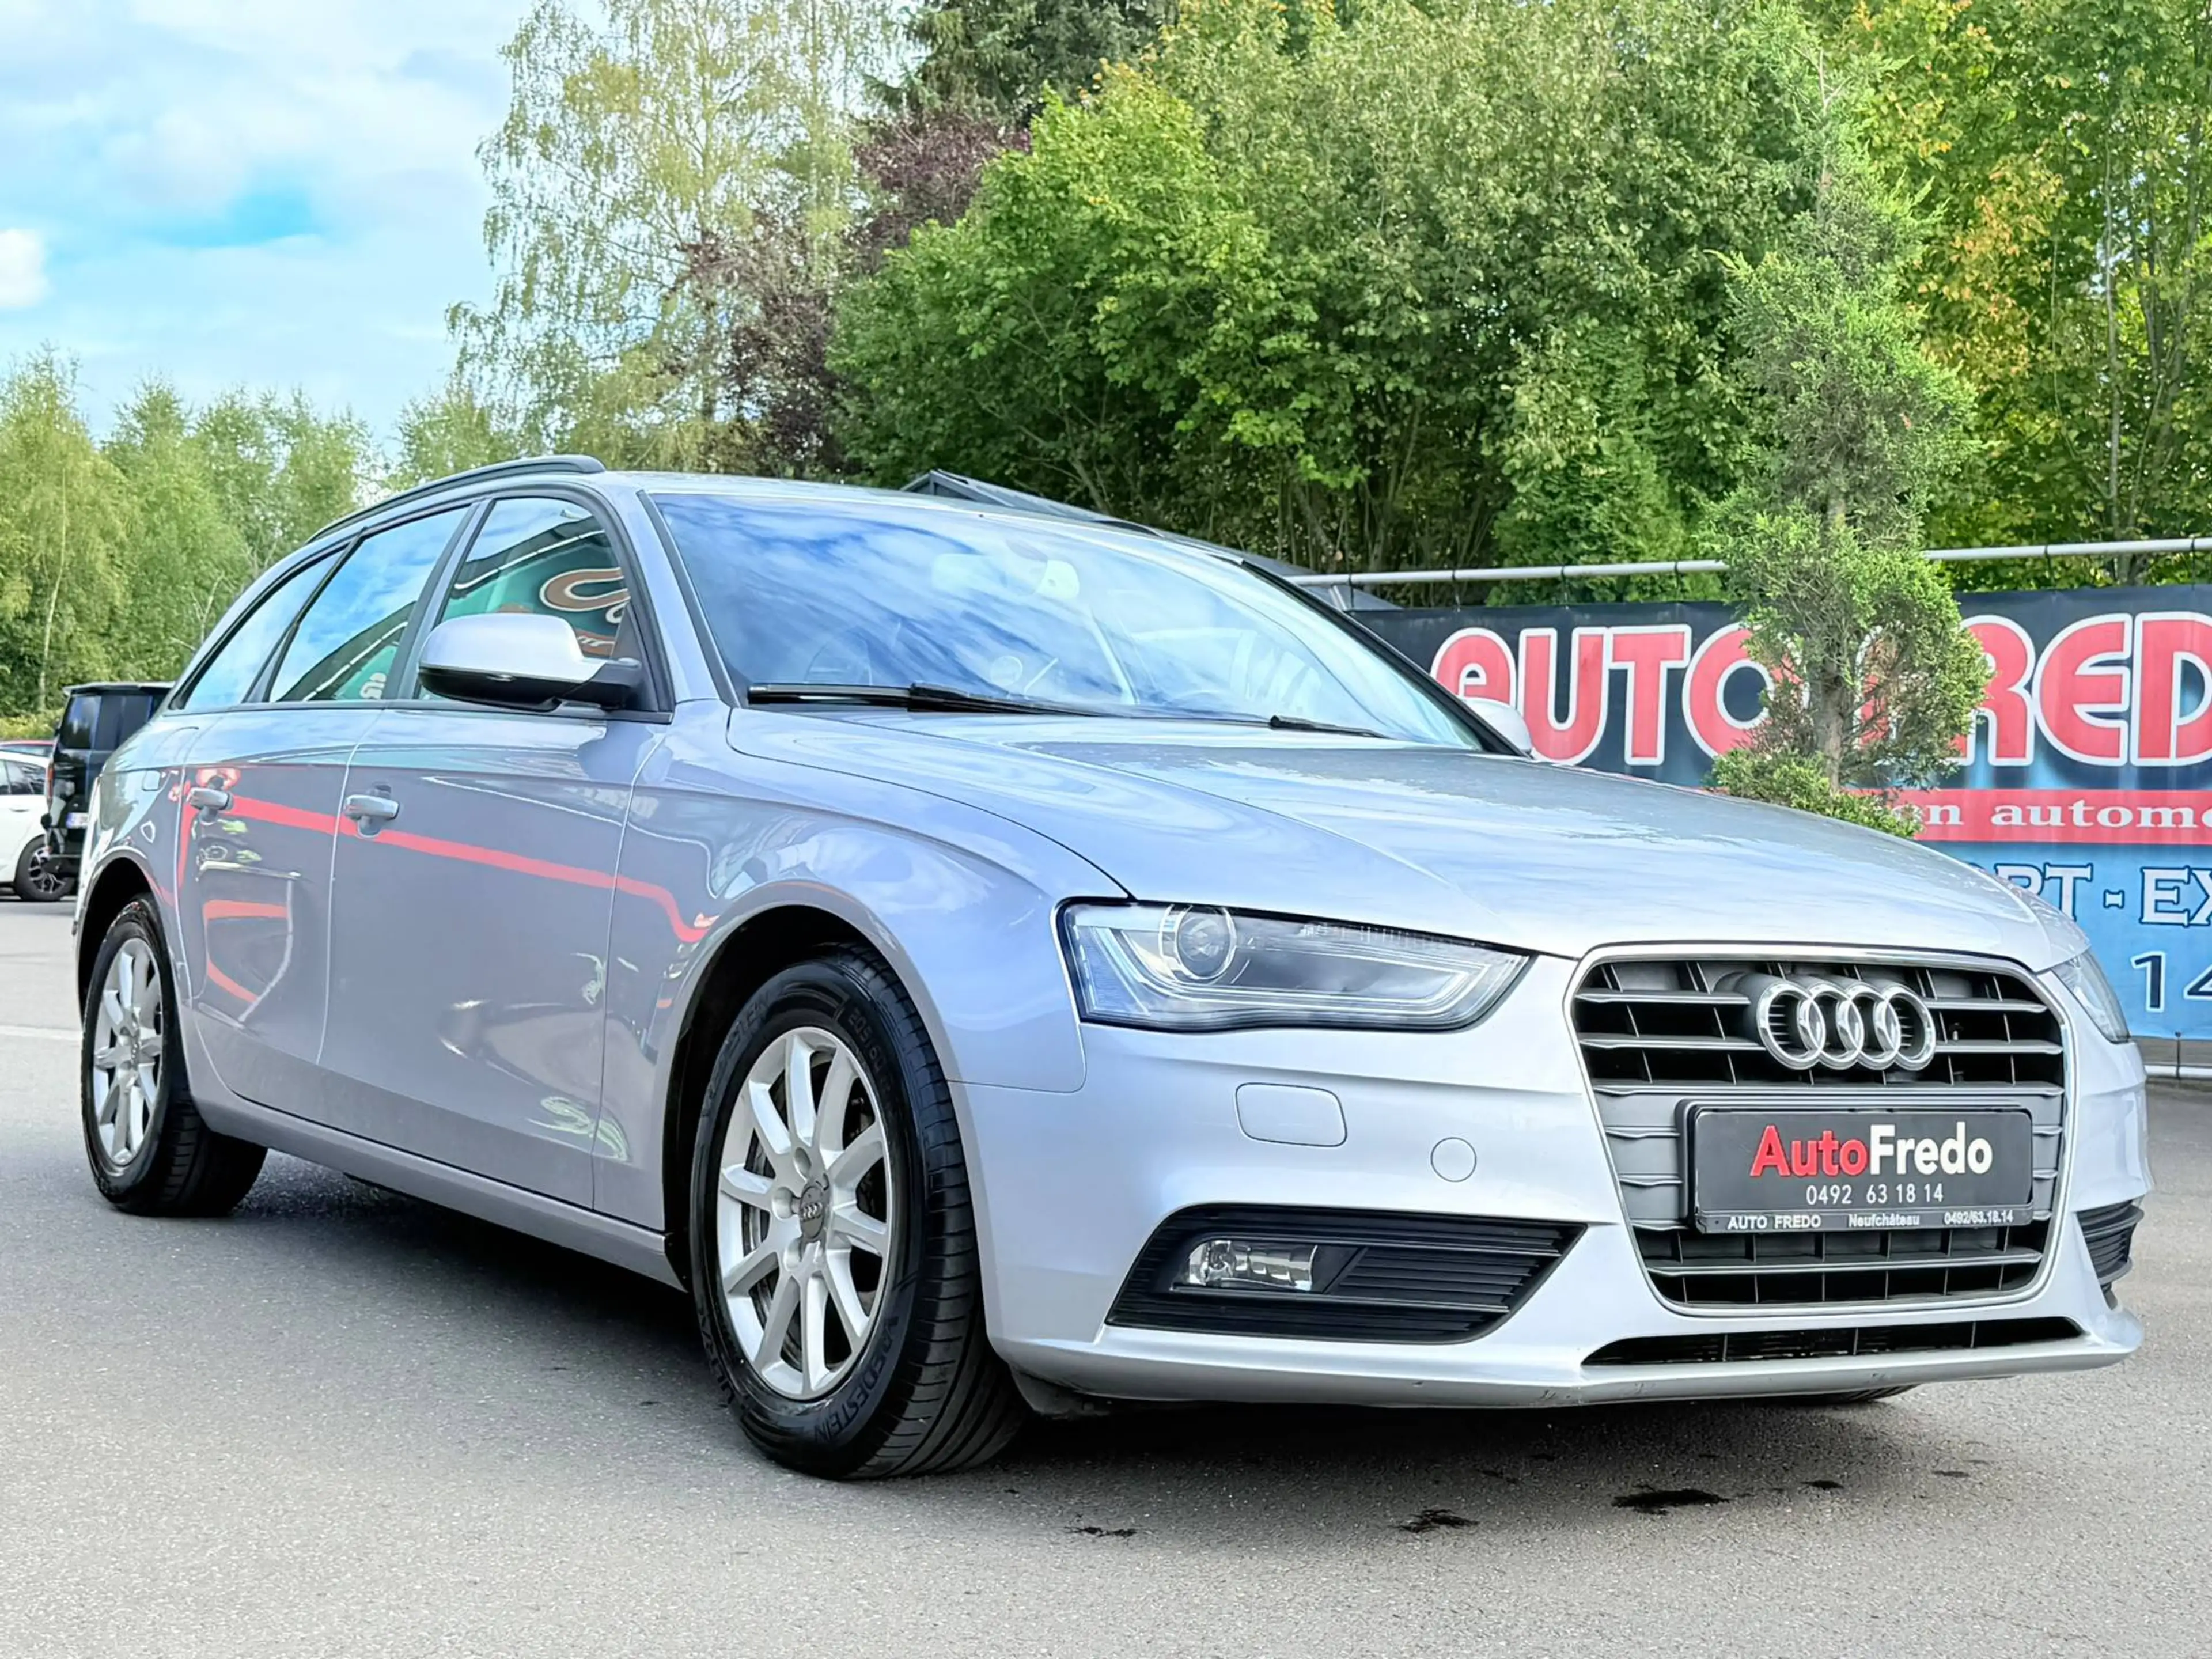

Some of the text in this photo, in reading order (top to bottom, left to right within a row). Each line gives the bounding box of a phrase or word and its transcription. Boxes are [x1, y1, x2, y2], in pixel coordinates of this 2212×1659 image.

[1853, 611, 2212, 767] RED
[1990, 799, 2212, 828] autom
[1749, 1121, 1993, 1177] AutoFredo
[1806, 1183, 1944, 1206] 0492 63 18 14
[1728, 1215, 1768, 1230] AUTO
[1774, 1214, 1821, 1229] FREDO
[1944, 1210, 2014, 1225] 0492/63.18.14
[813, 1314, 901, 1444] VREDESTEIN
